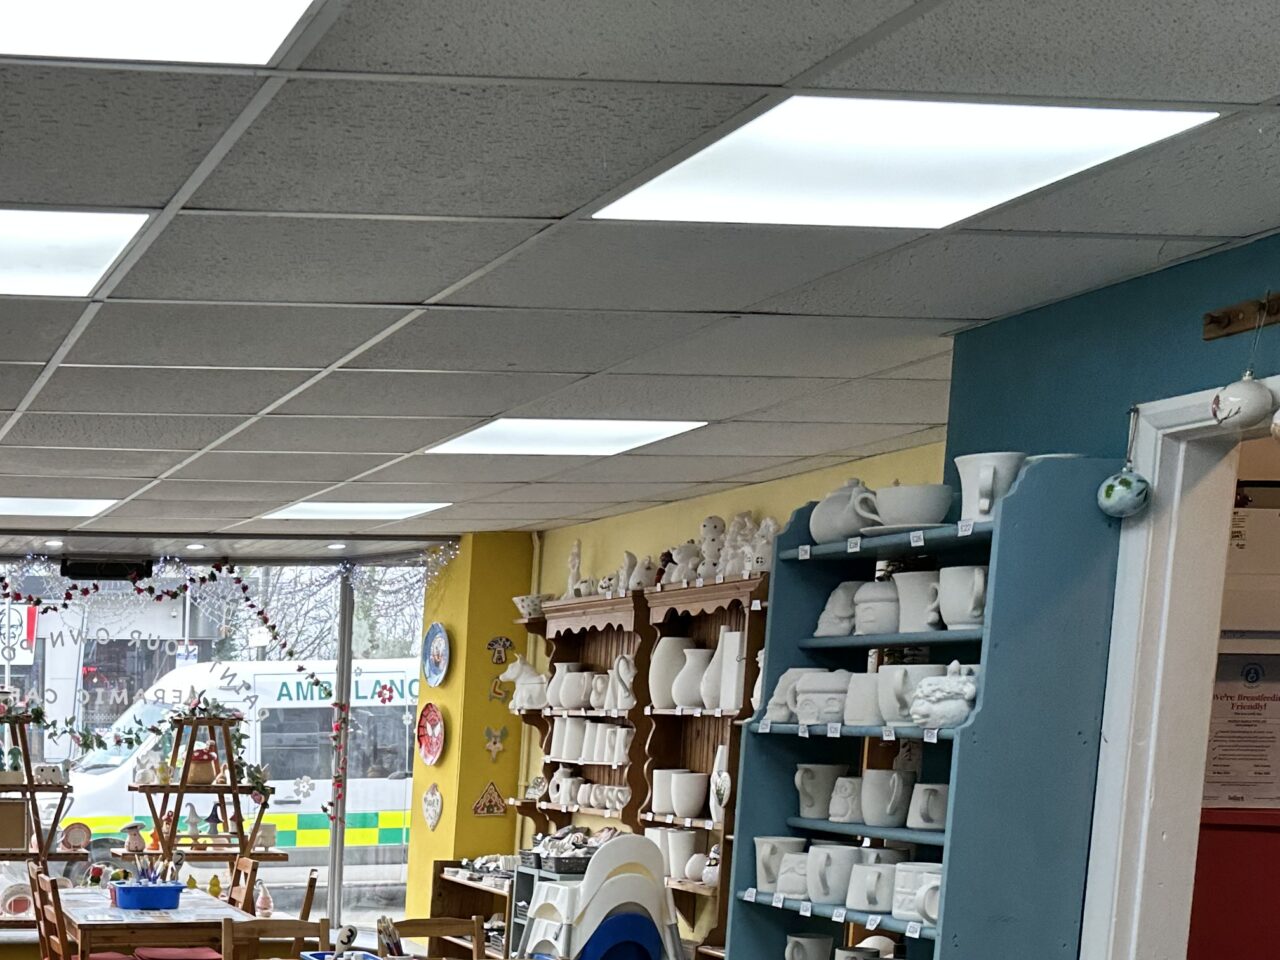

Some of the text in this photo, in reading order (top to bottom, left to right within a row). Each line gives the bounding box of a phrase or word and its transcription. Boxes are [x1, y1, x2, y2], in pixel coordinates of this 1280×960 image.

[276, 678, 420, 702] AMBLANC
[175, 852, 184, 865] 2
[340, 928, 354, 946] 3
